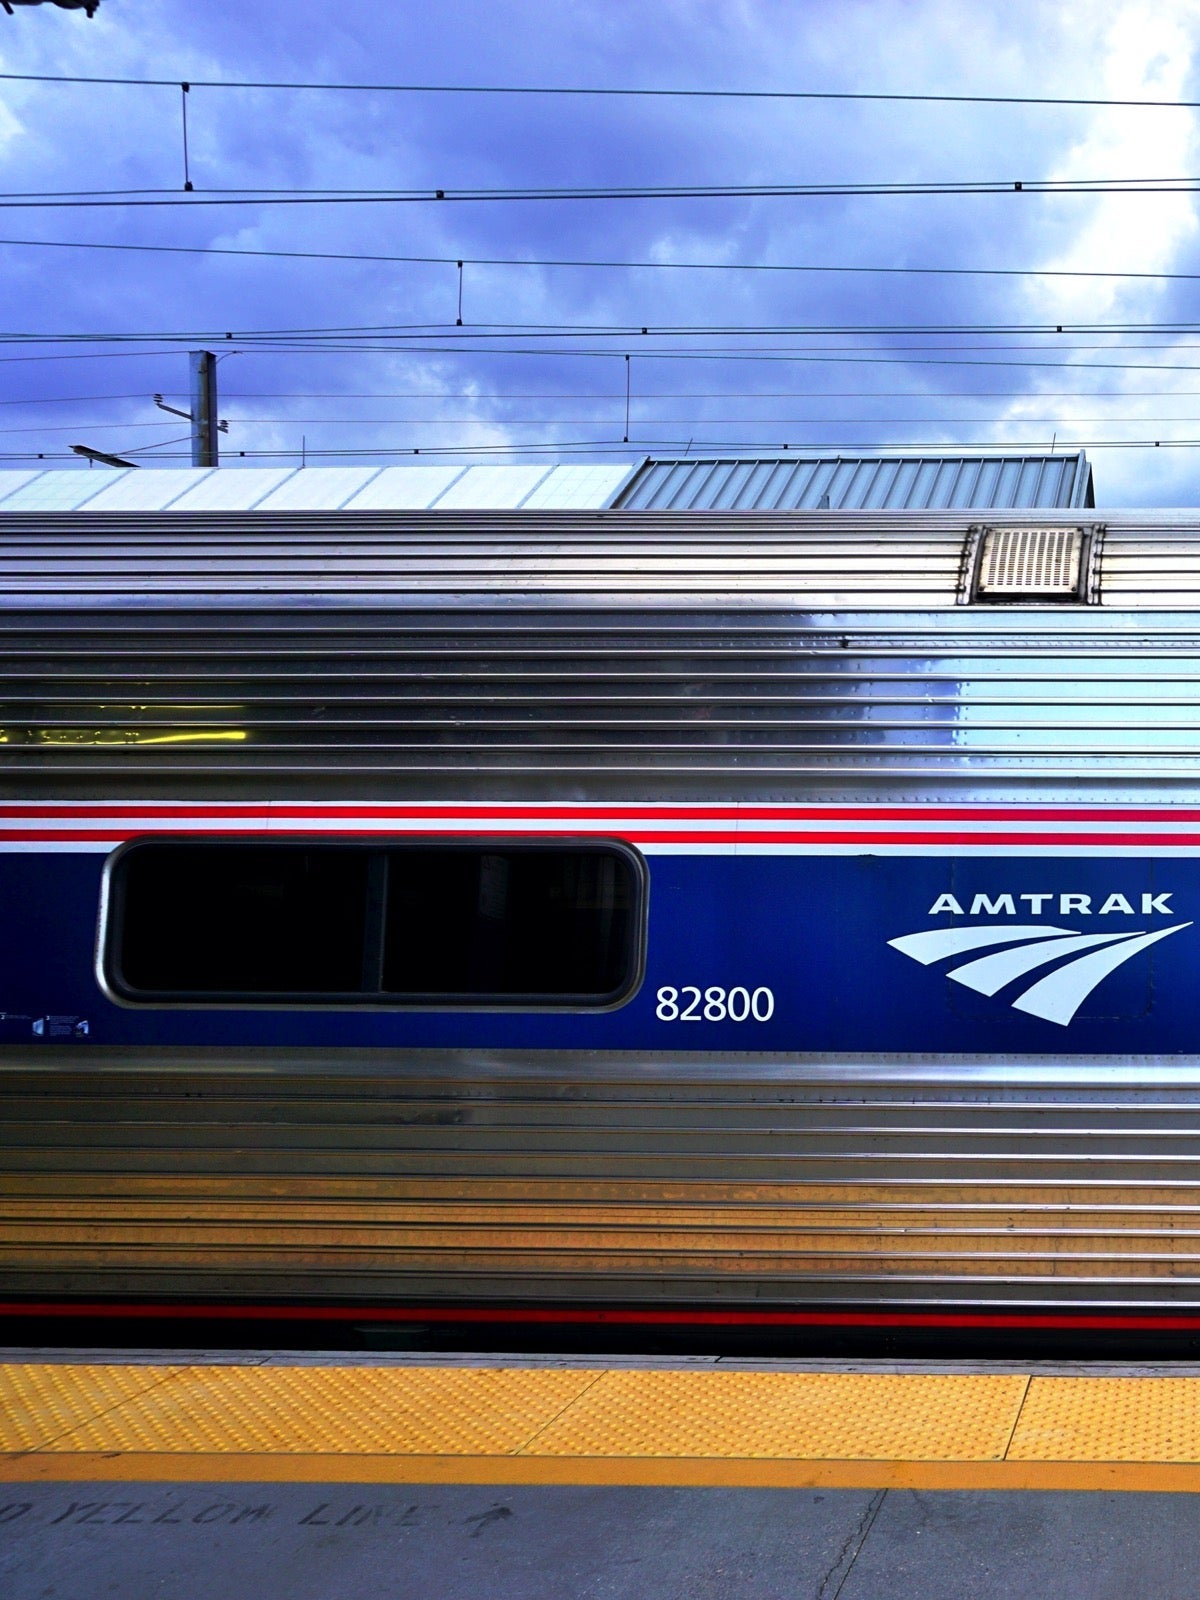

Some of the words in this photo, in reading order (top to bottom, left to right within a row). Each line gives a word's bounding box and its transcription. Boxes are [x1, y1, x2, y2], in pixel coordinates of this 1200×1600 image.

[928, 893, 1174, 915] AMTRAK
[655, 986, 775, 1022] 82800
[49, 1501, 274, 1526] YELLOW
